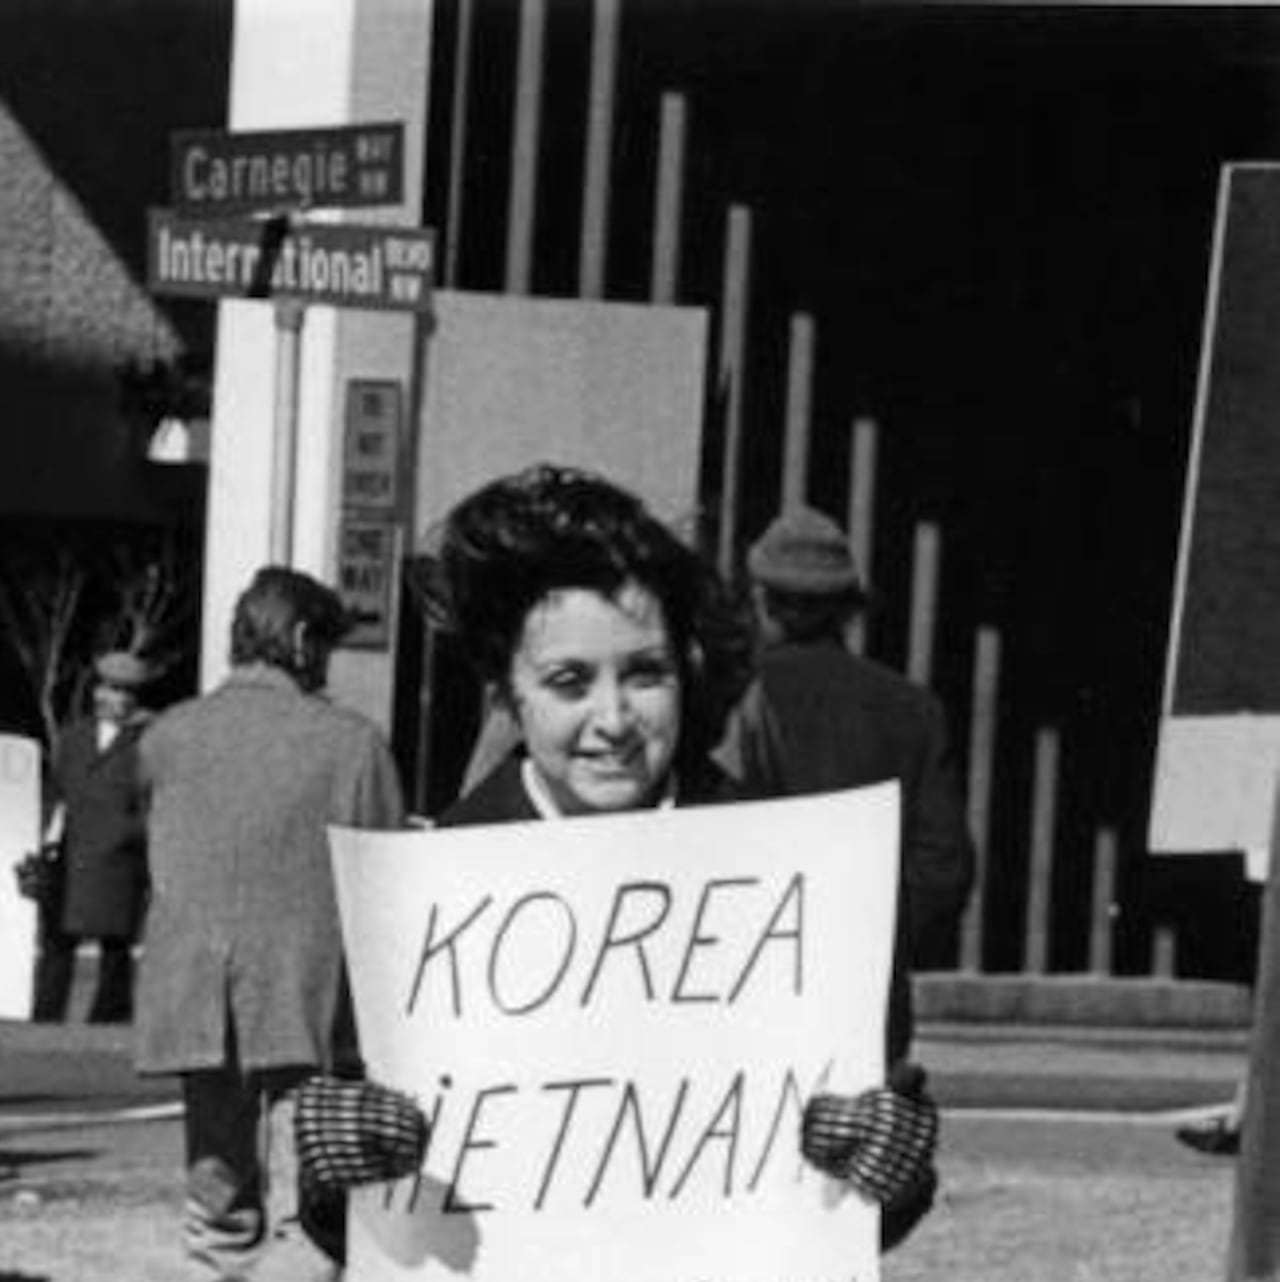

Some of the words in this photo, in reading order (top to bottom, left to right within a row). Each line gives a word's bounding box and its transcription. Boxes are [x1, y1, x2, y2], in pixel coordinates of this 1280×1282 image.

[186, 146, 347, 206] Carnegie
[158, 226, 383, 295] Interntional
[406, 872, 804, 1017] KOREA
